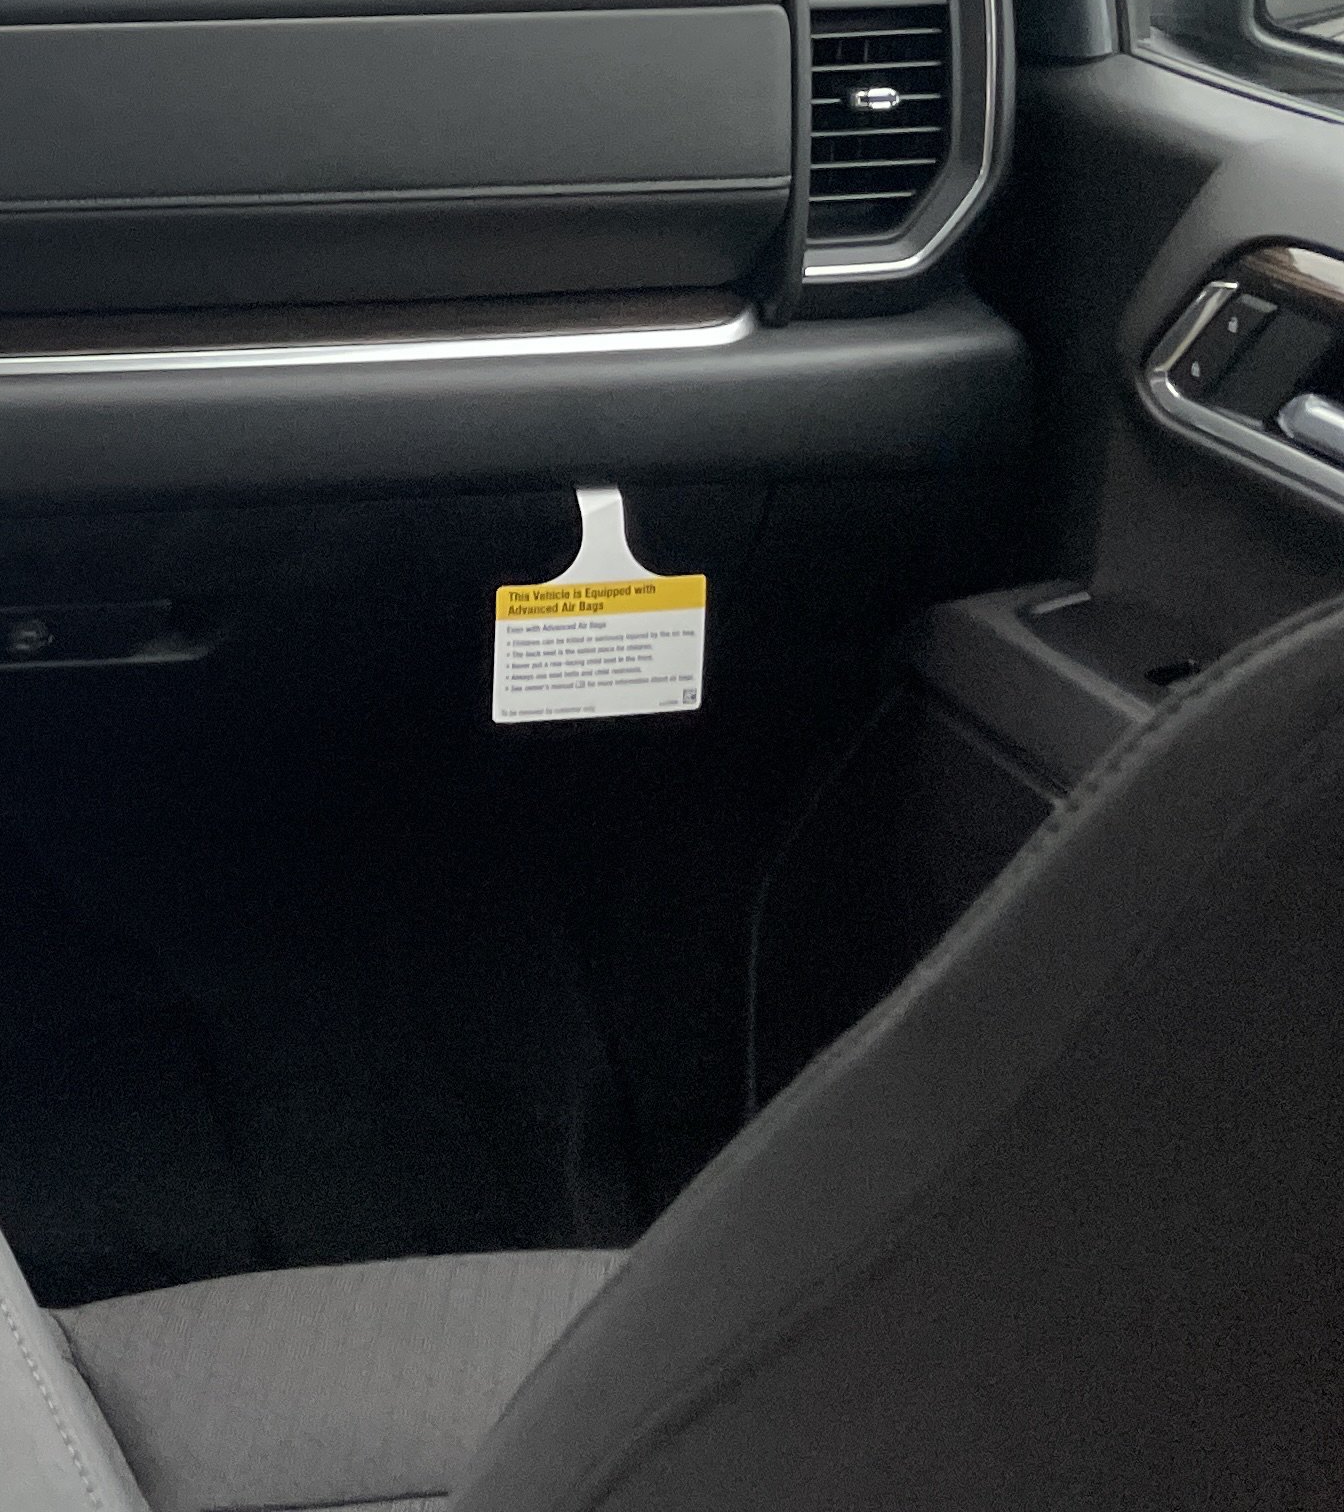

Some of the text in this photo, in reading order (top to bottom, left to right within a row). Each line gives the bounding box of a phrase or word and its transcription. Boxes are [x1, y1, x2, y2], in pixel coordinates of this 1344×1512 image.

[508, 584, 656, 602] This Vehicle is Equipped with
[507, 601, 604, 616] Advanced Air Bags
